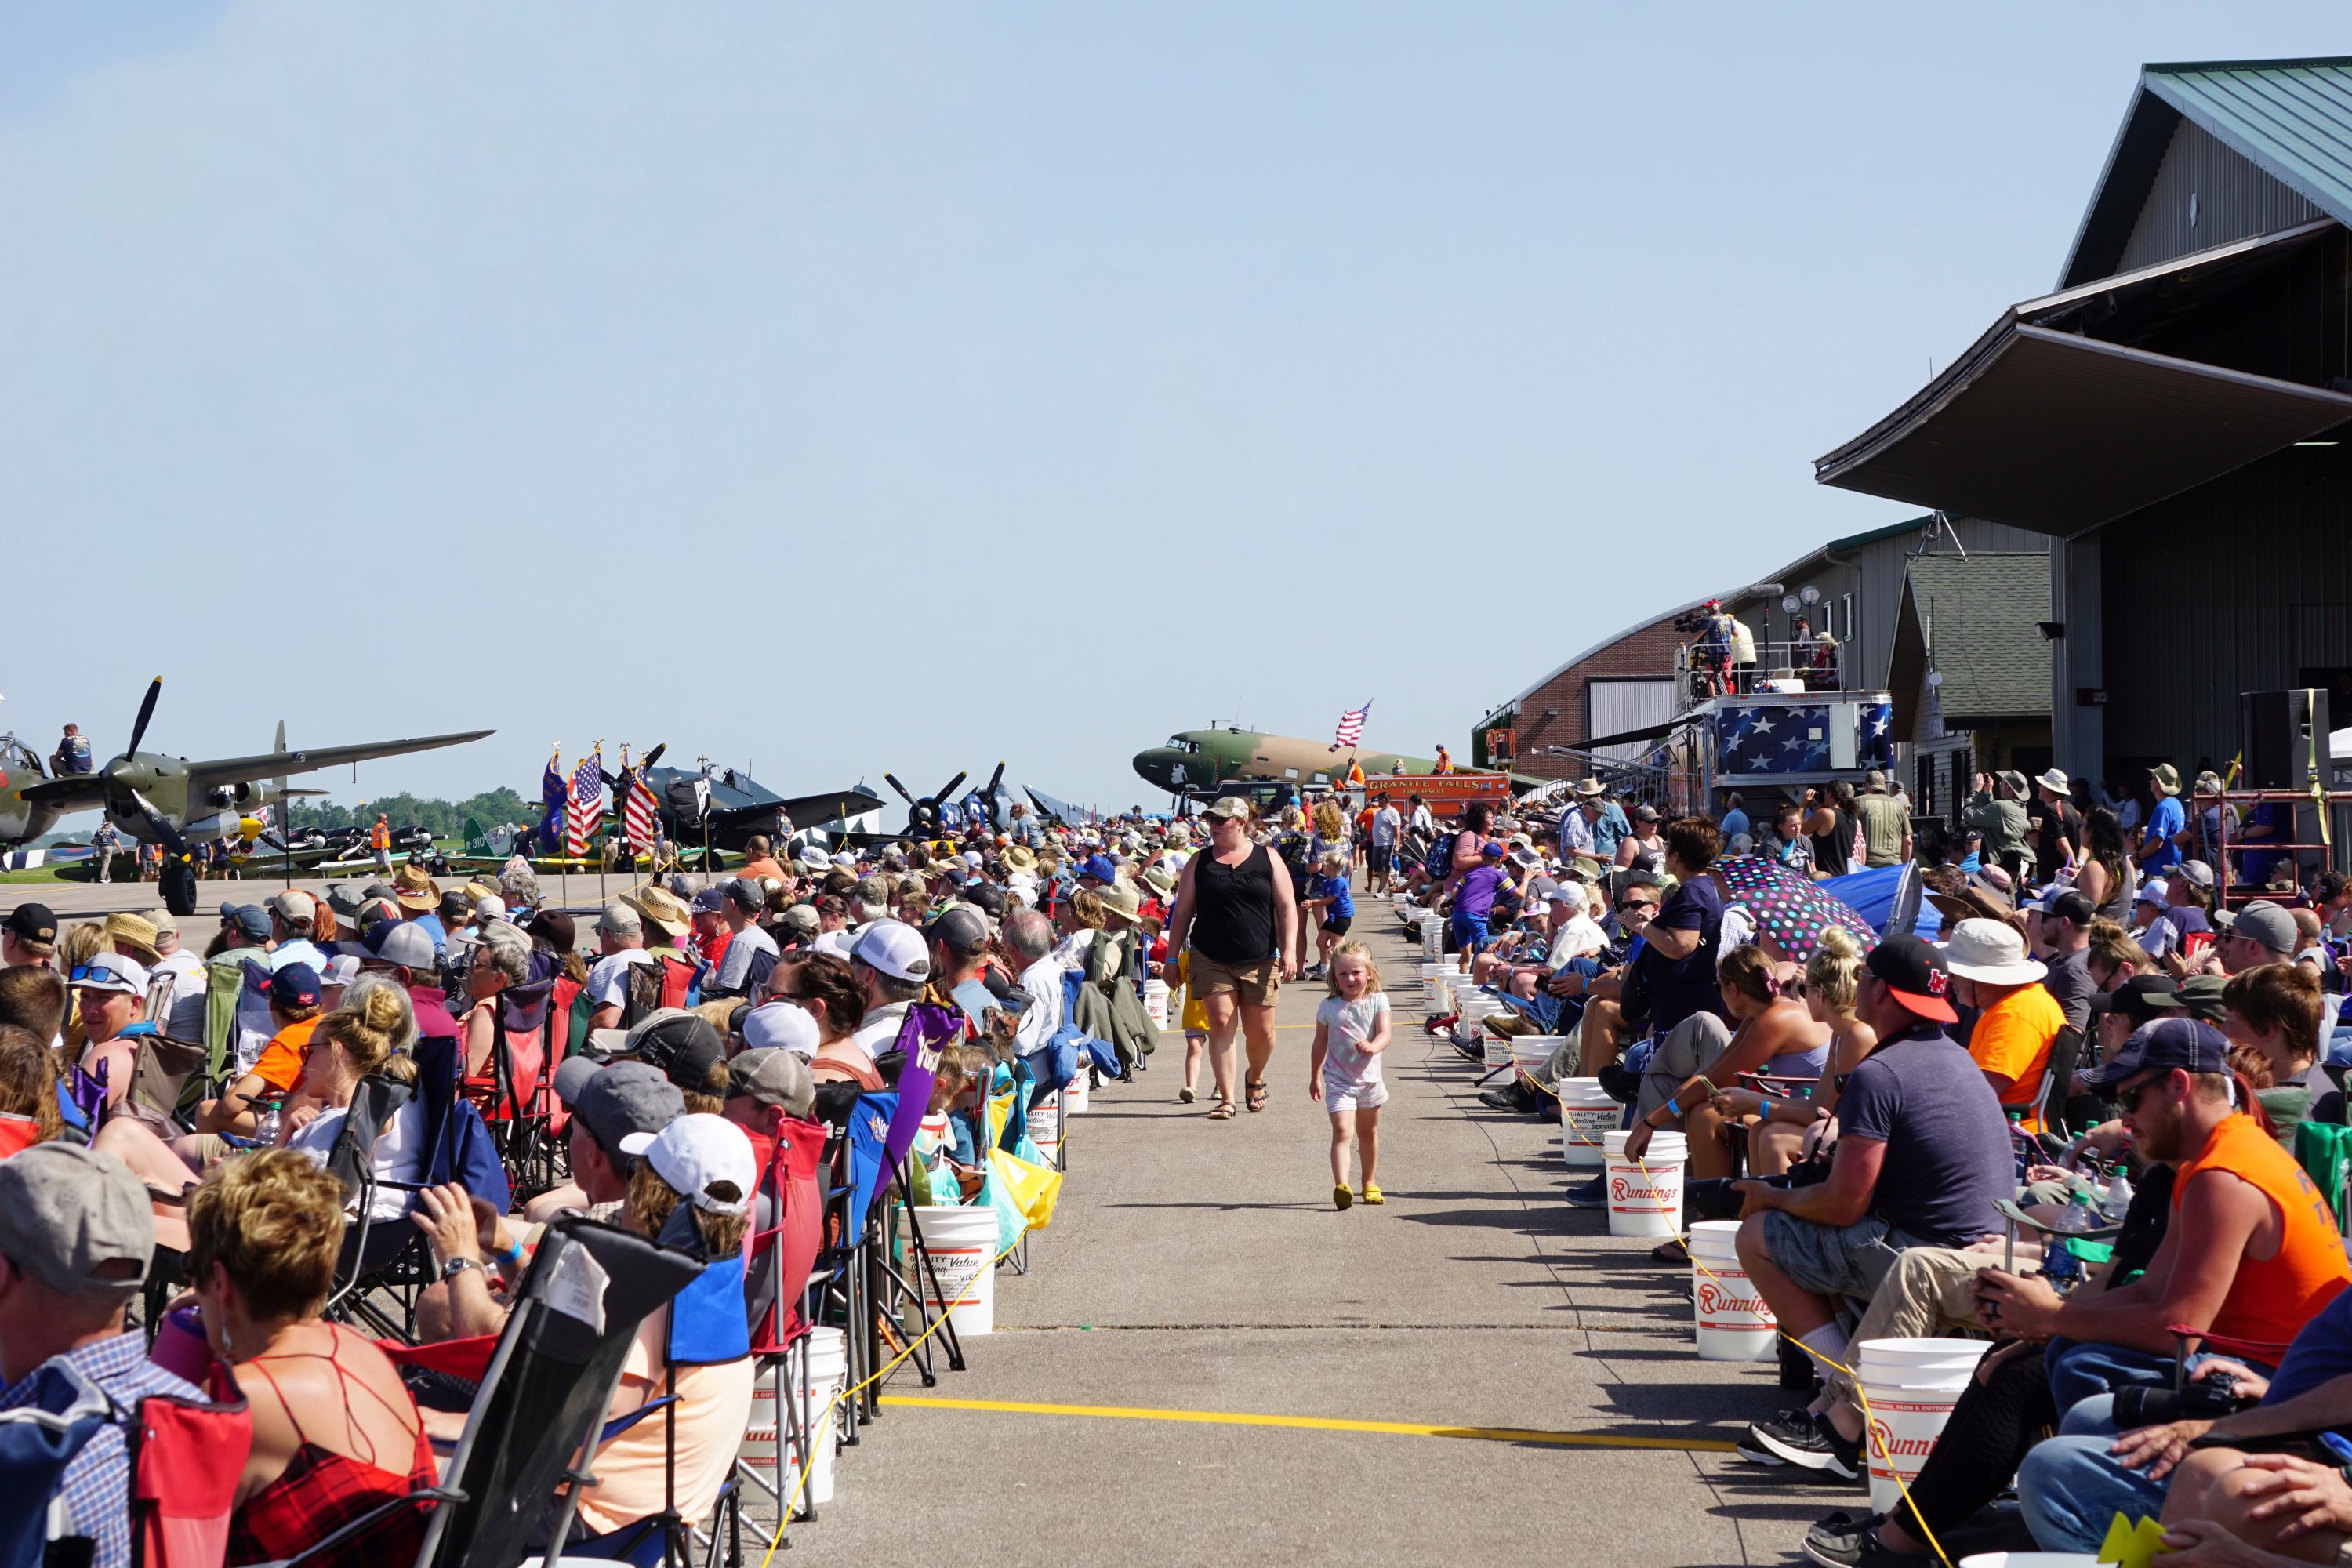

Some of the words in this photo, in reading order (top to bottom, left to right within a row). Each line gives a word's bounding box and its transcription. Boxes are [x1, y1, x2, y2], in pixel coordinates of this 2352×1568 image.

[1369, 781, 1430, 790] GRANITE
[1438, 780, 1479, 789] FALLS
[1324, 837, 1348, 846] STAFF
[1597, 1112, 1617, 1121] Value
[1611, 1178, 1678, 1202] Runnings
[949, 1256, 979, 1268] Value
[1698, 1283, 1772, 1316] Running
